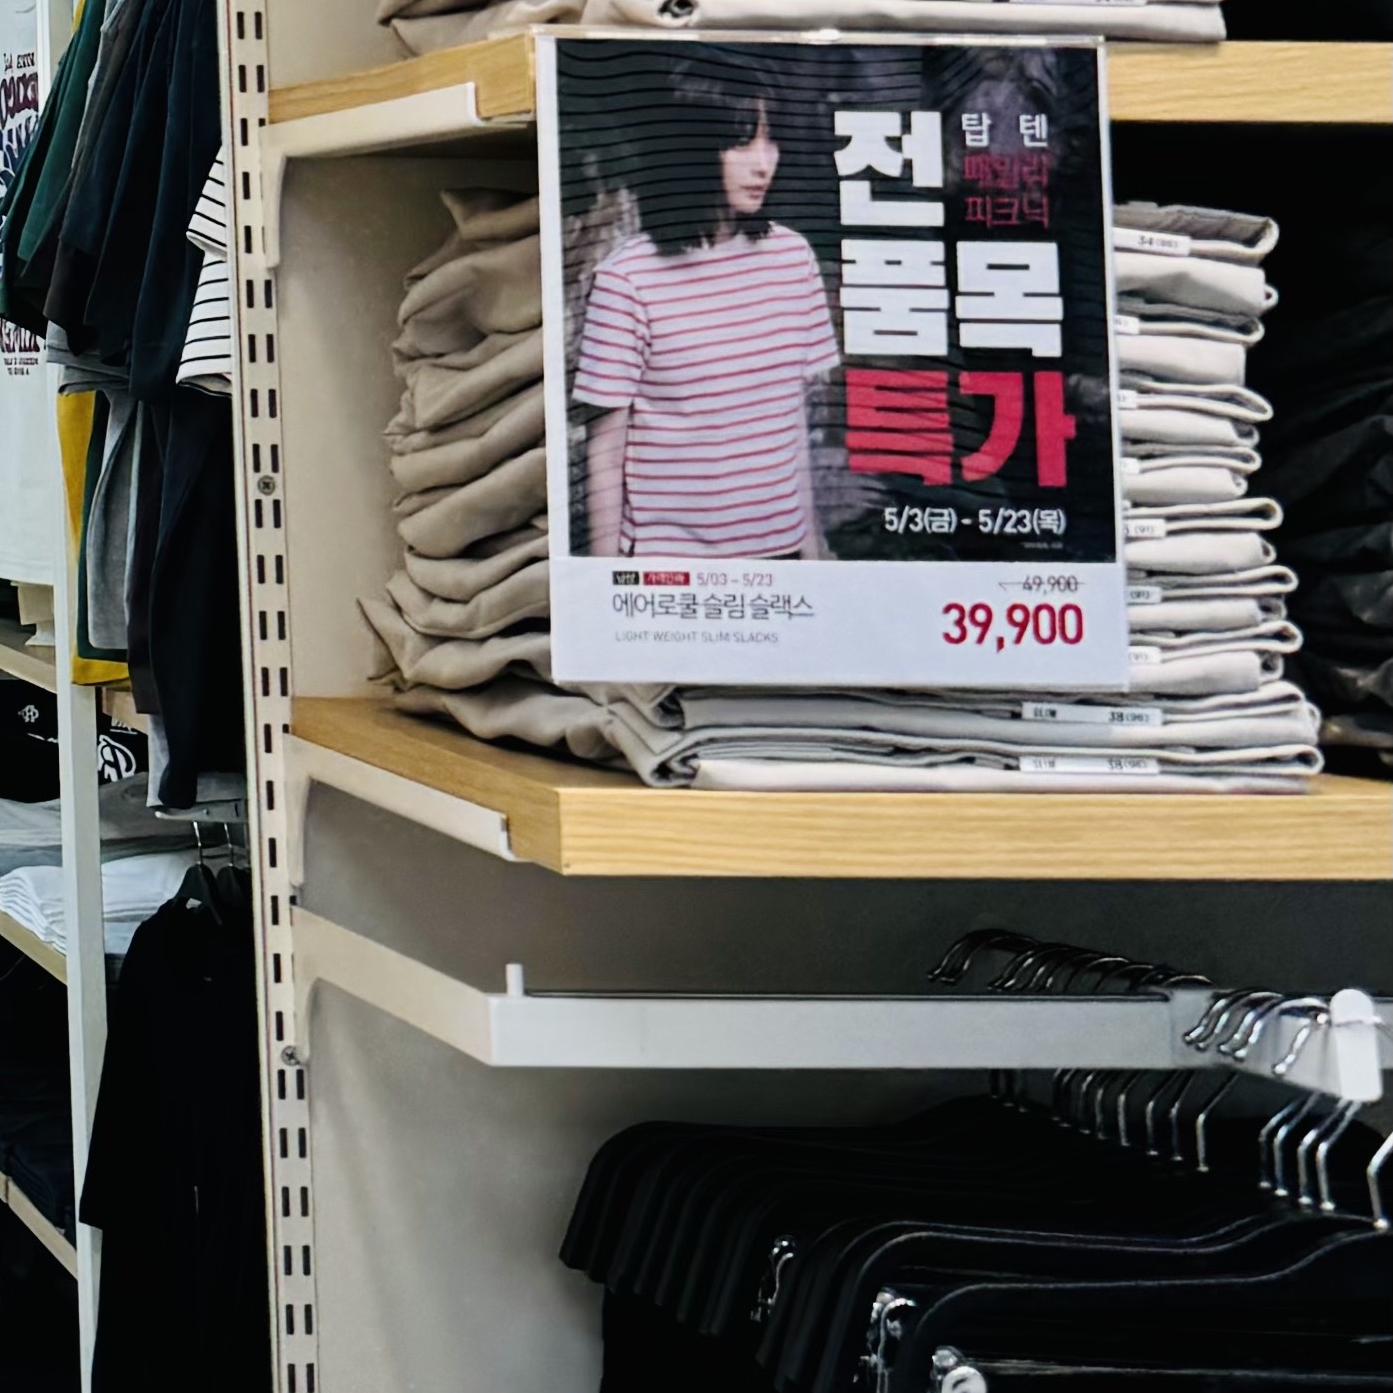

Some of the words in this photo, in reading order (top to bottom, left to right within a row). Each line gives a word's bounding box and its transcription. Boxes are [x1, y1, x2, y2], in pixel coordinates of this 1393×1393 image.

[834, 111, 945, 227] 전
[840, 239, 1063, 357] 품목
[845, 368, 1077, 487] 특가
[884, 506, 958, 535] 5/3(금)
[978, 507, 1068, 536] 5/23(목)
[612, 592, 698, 621] 에어로쿨
[703, 593, 746, 621] 슬림
[750, 593, 815, 621] 슬랙스
[941, 601, 1084, 653] 39,900
[615, 630, 648, 643] LIGHT
[653, 630, 698, 643] WEIGHT
[701, 630, 731, 643] SLIM
[733, 630, 779, 644] SLACKS
